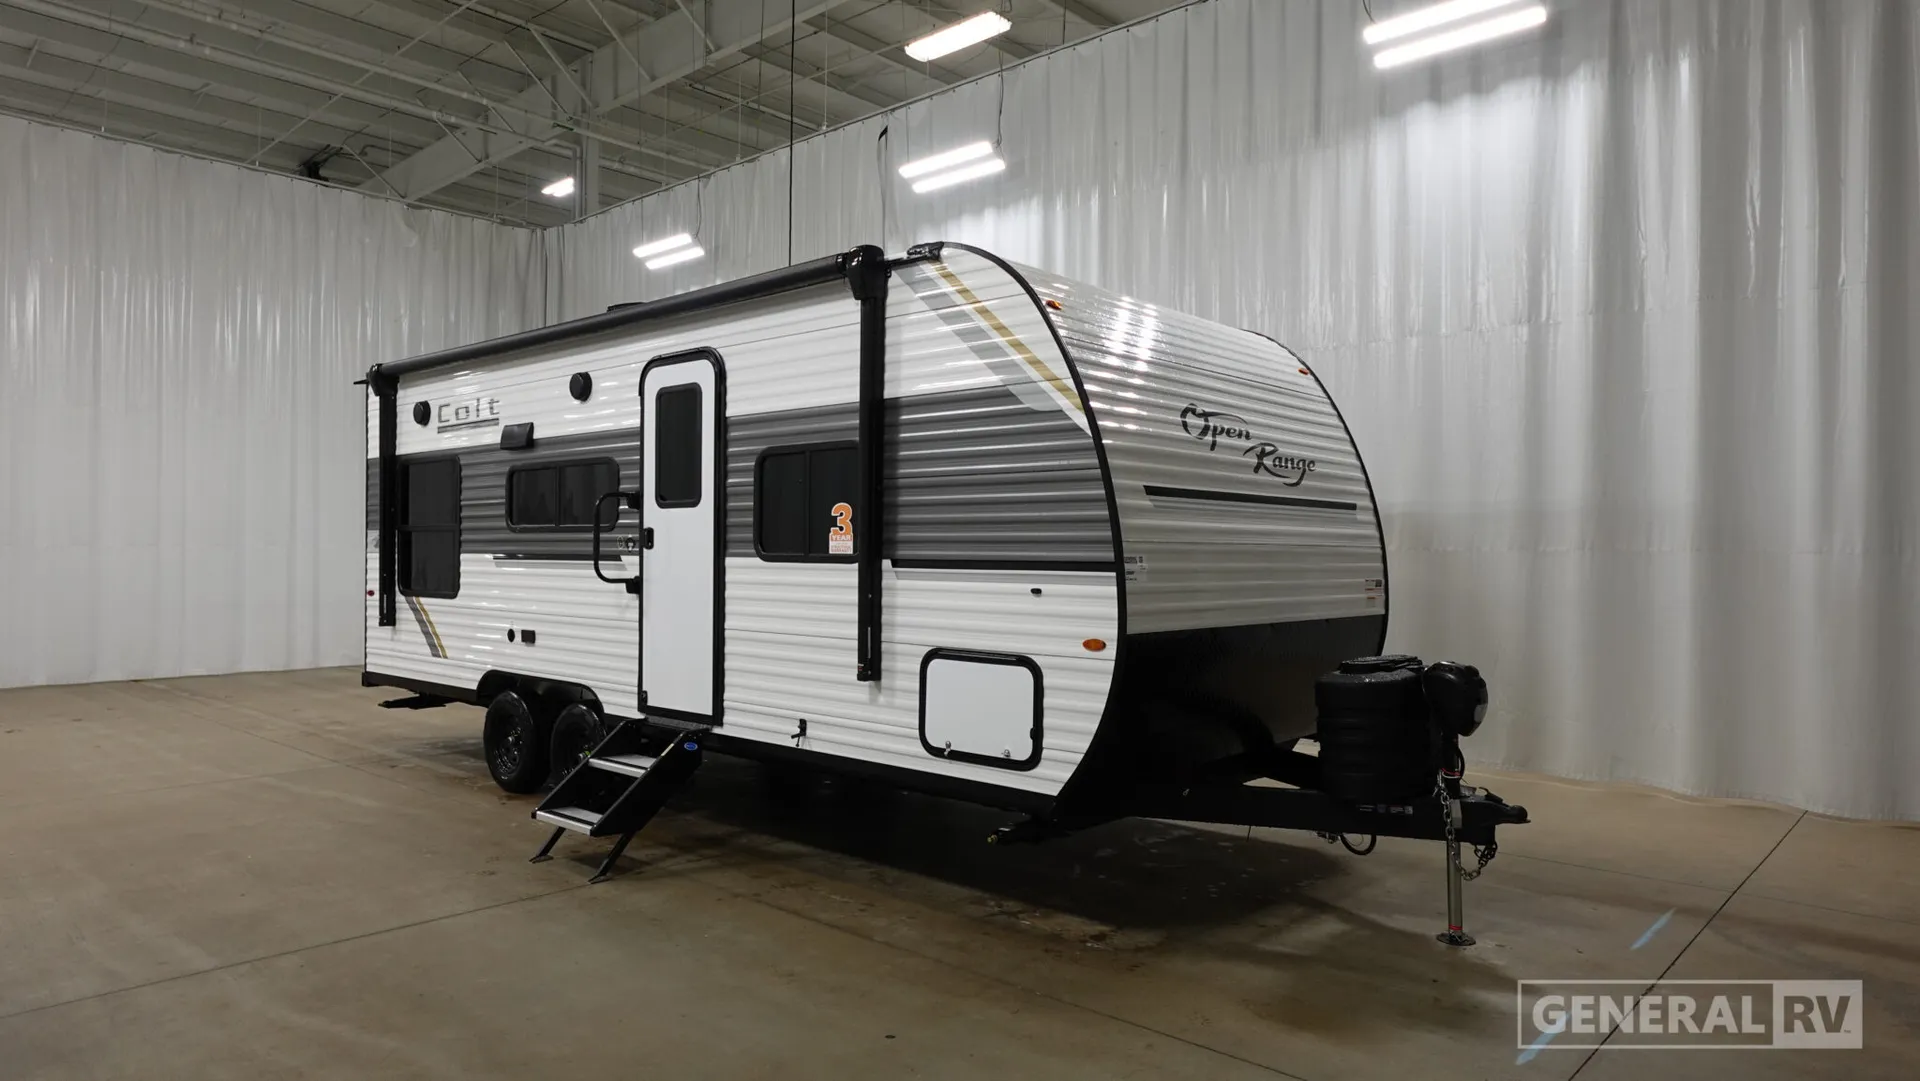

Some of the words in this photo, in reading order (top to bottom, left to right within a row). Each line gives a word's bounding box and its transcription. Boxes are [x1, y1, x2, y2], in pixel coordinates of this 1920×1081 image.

[438, 398, 500, 423] Colt
[1180, 403, 1251, 452] Open
[1243, 442, 1316, 487] Range
[831, 502, 853, 535] 3
